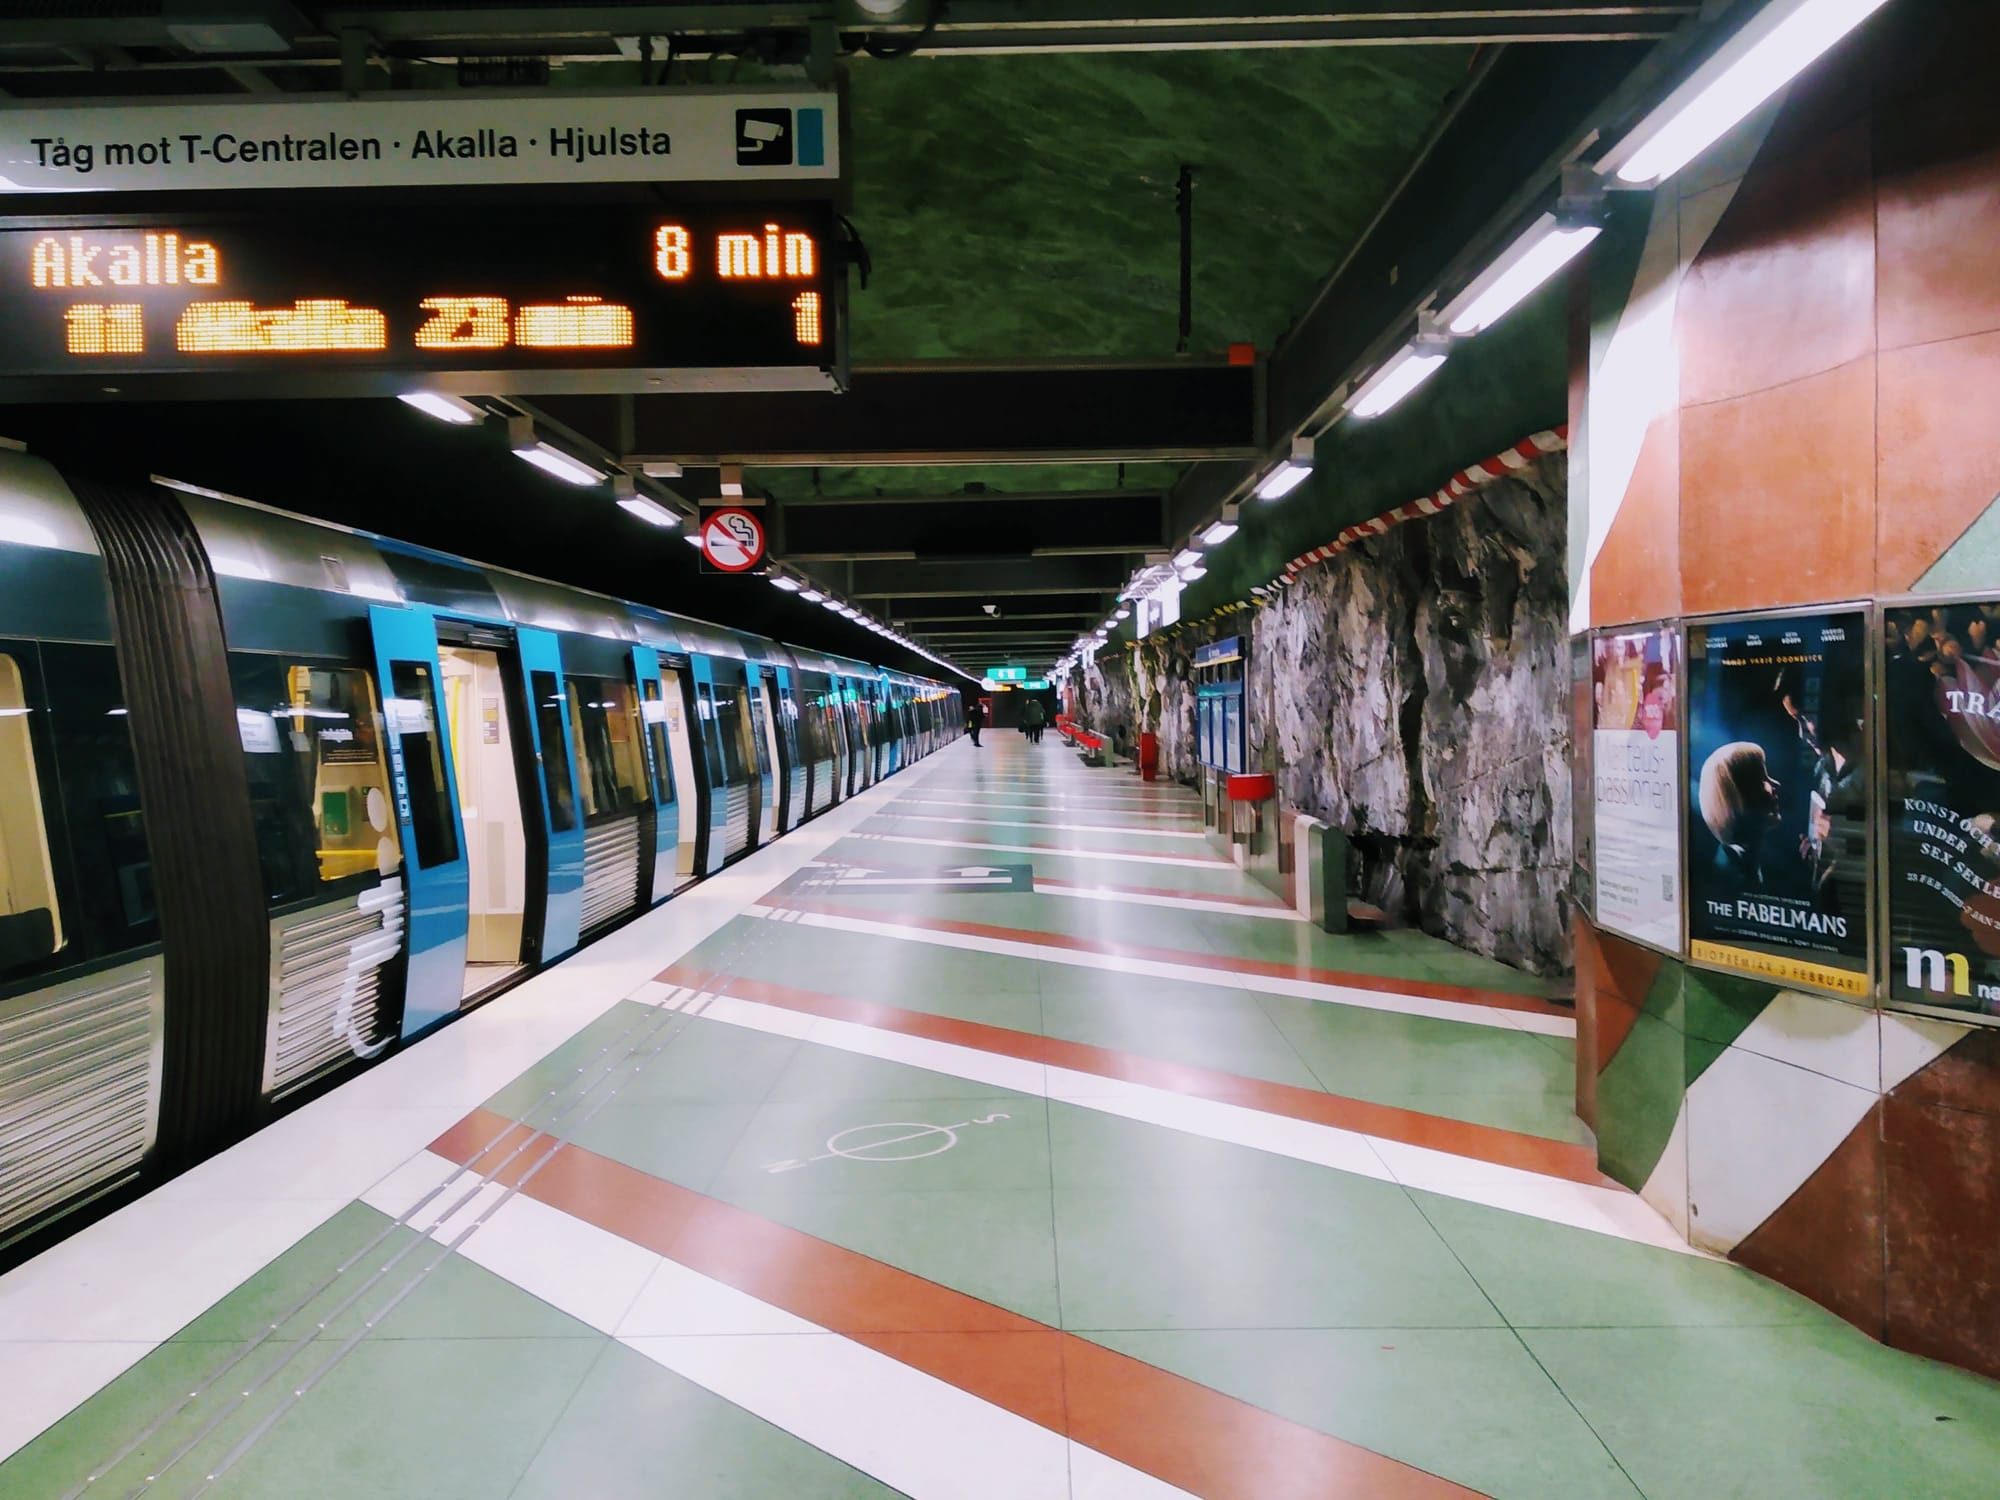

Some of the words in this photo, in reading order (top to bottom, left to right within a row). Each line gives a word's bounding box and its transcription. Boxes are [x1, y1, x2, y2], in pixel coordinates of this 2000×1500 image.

[31, 138, 94, 173] Tåg
[105, 137, 171, 165] mot
[179, 132, 381, 164] T-Centralen
[412, 129, 518, 159] Akalla
[550, 127, 671, 163] Hjulsta
[33, 234, 218, 287] Akalla
[655, 225, 689, 277] 8
[717, 223, 813, 276] min
[1904, 798, 1960, 824] KONST
[1960, 818, 1993, 849] OCH
[1914, 820, 1968, 854] UNDER
[1920, 842, 1954, 866] SEX
[1919, 873, 1943, 891] FEB
[1706, 900, 1733, 918] THE
[1737, 900, 1848, 938] FABELMANS
[1793, 967, 1861, 993] FEBRUARI
